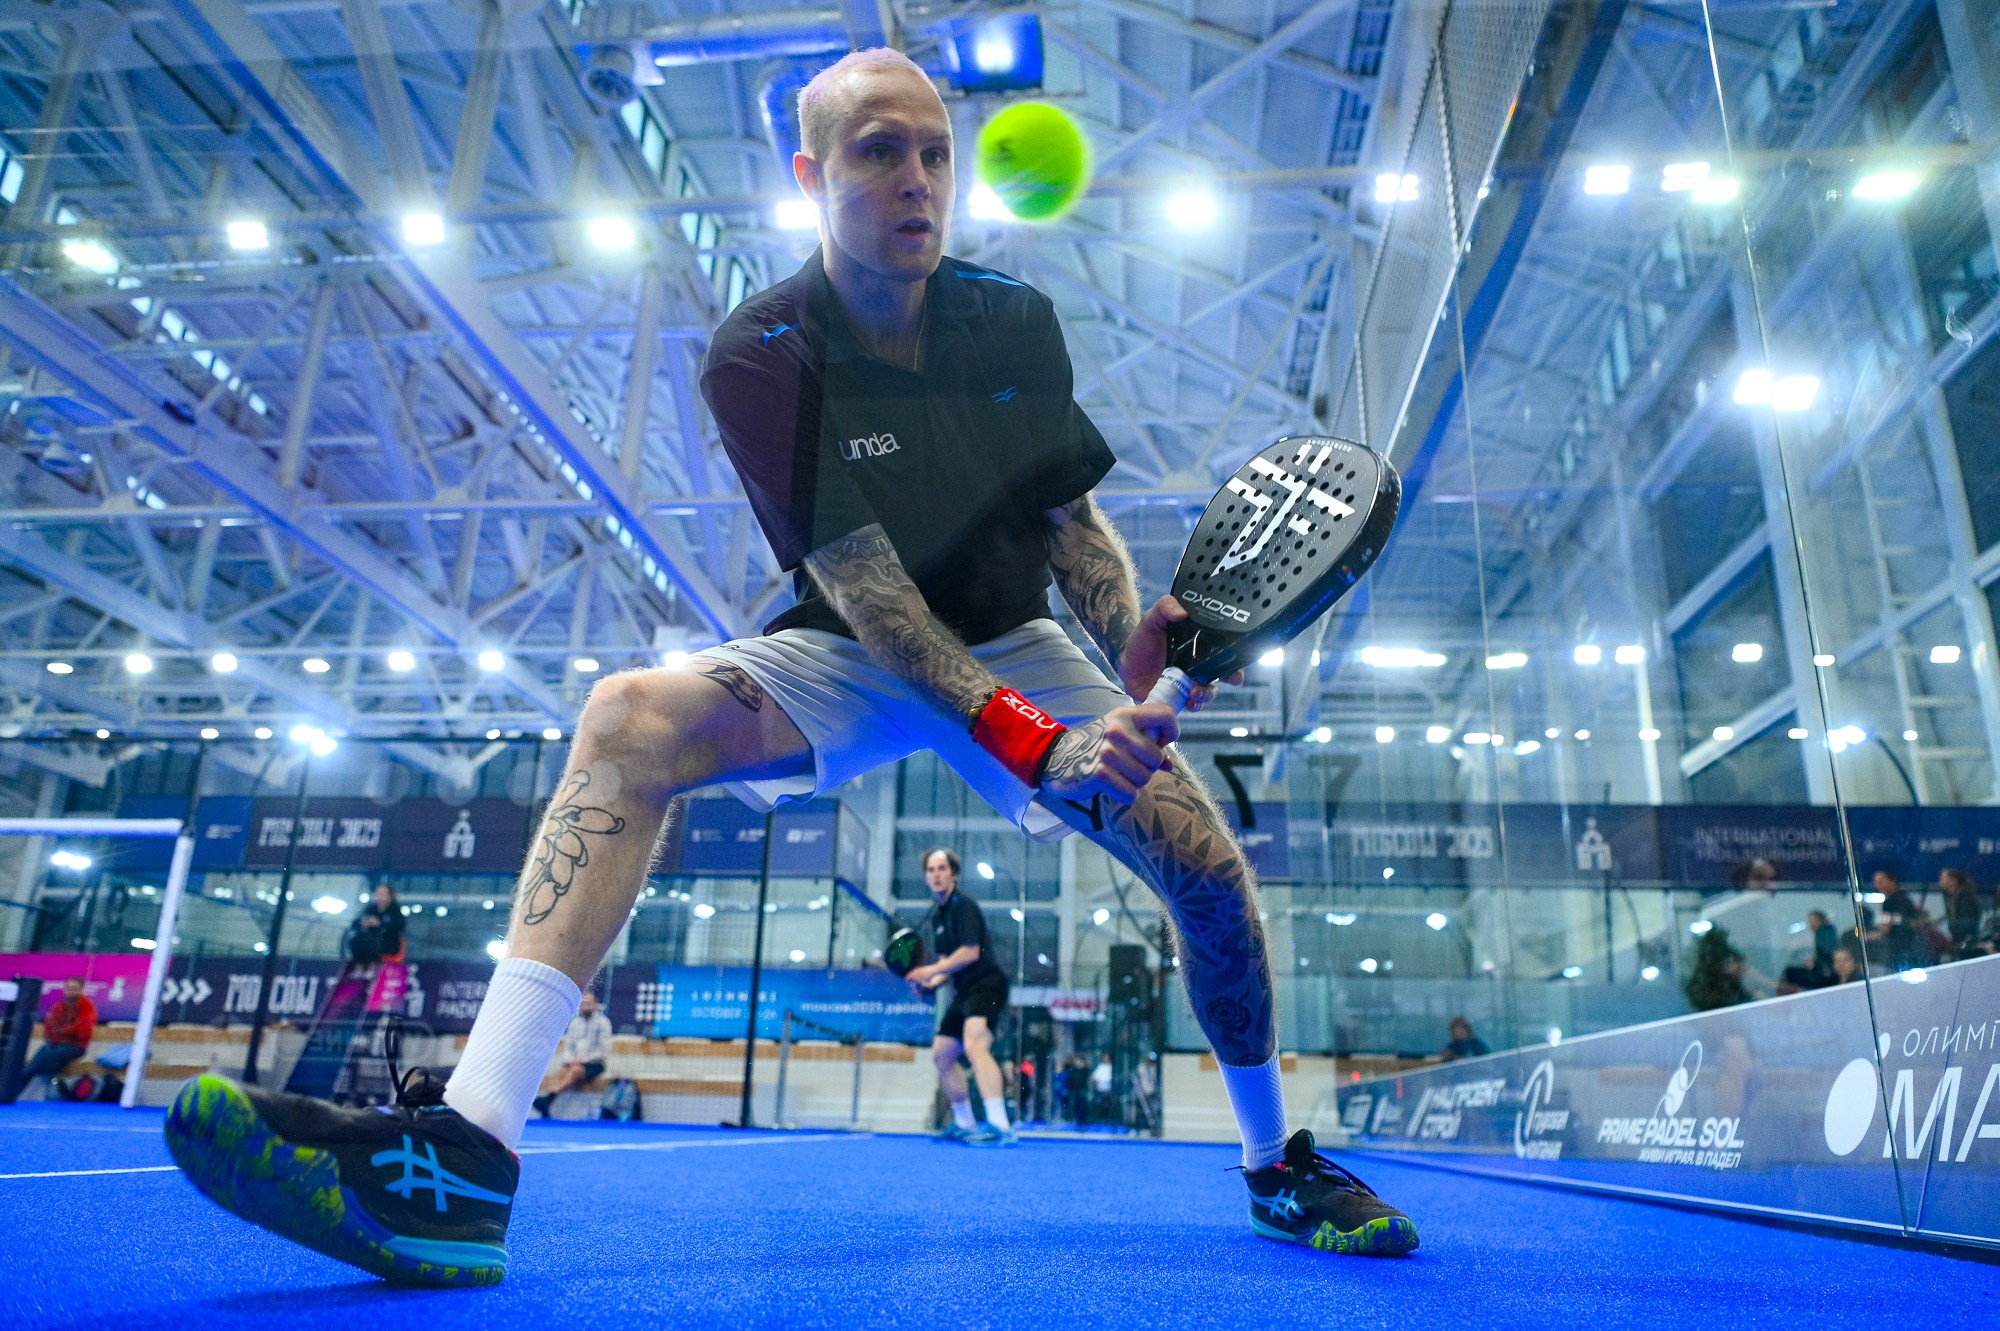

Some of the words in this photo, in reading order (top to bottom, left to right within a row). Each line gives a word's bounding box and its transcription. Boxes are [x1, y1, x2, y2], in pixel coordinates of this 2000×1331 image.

[838, 432, 901, 461] unda
[1181, 589, 1251, 623] OXDOG
[1597, 1117, 1647, 1145] PRIME
[1643, 1117, 1698, 1147] PADEL
